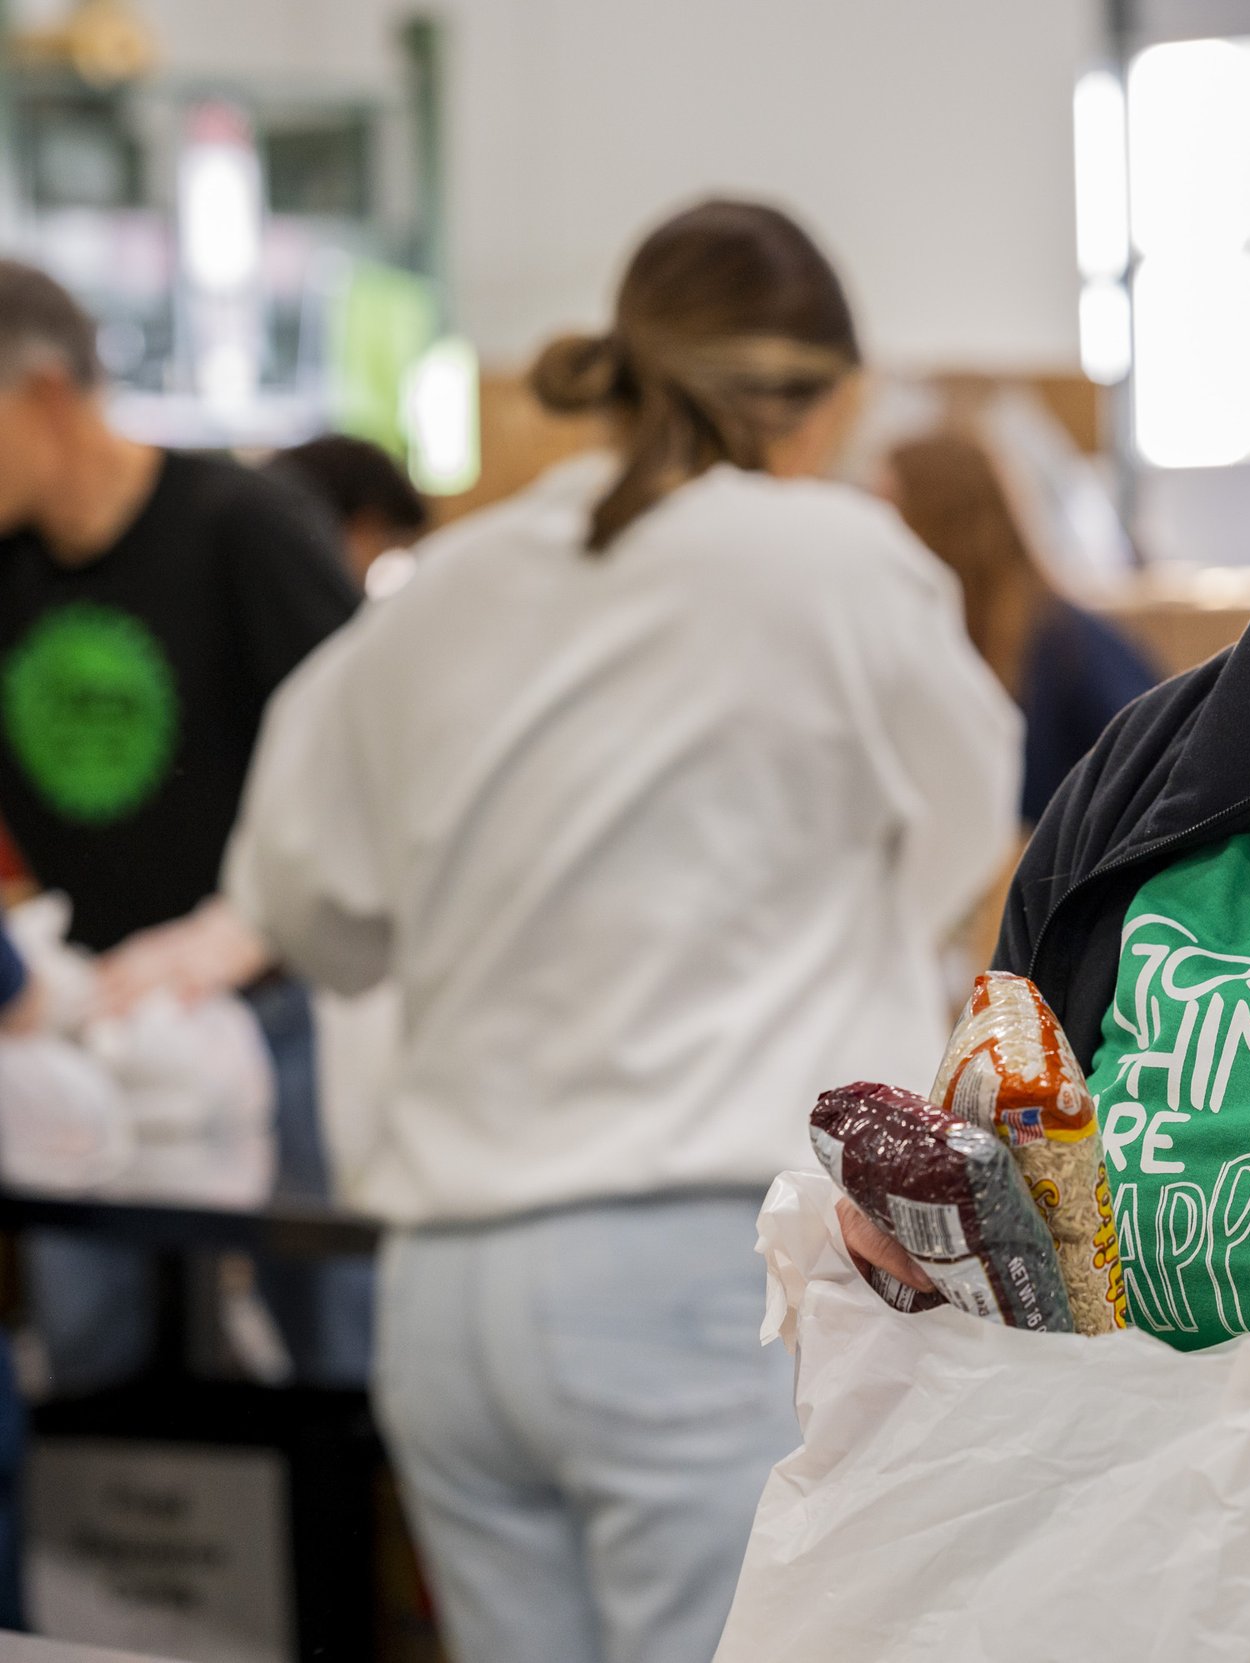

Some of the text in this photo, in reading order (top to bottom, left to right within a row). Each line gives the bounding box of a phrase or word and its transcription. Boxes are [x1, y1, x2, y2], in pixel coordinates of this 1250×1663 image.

[1095, 1094, 1192, 1174] RE
[1007, 1256, 1030, 1287] NET
[1018, 1283, 1036, 1309] WT
[1026, 1307, 1042, 1327] 16
